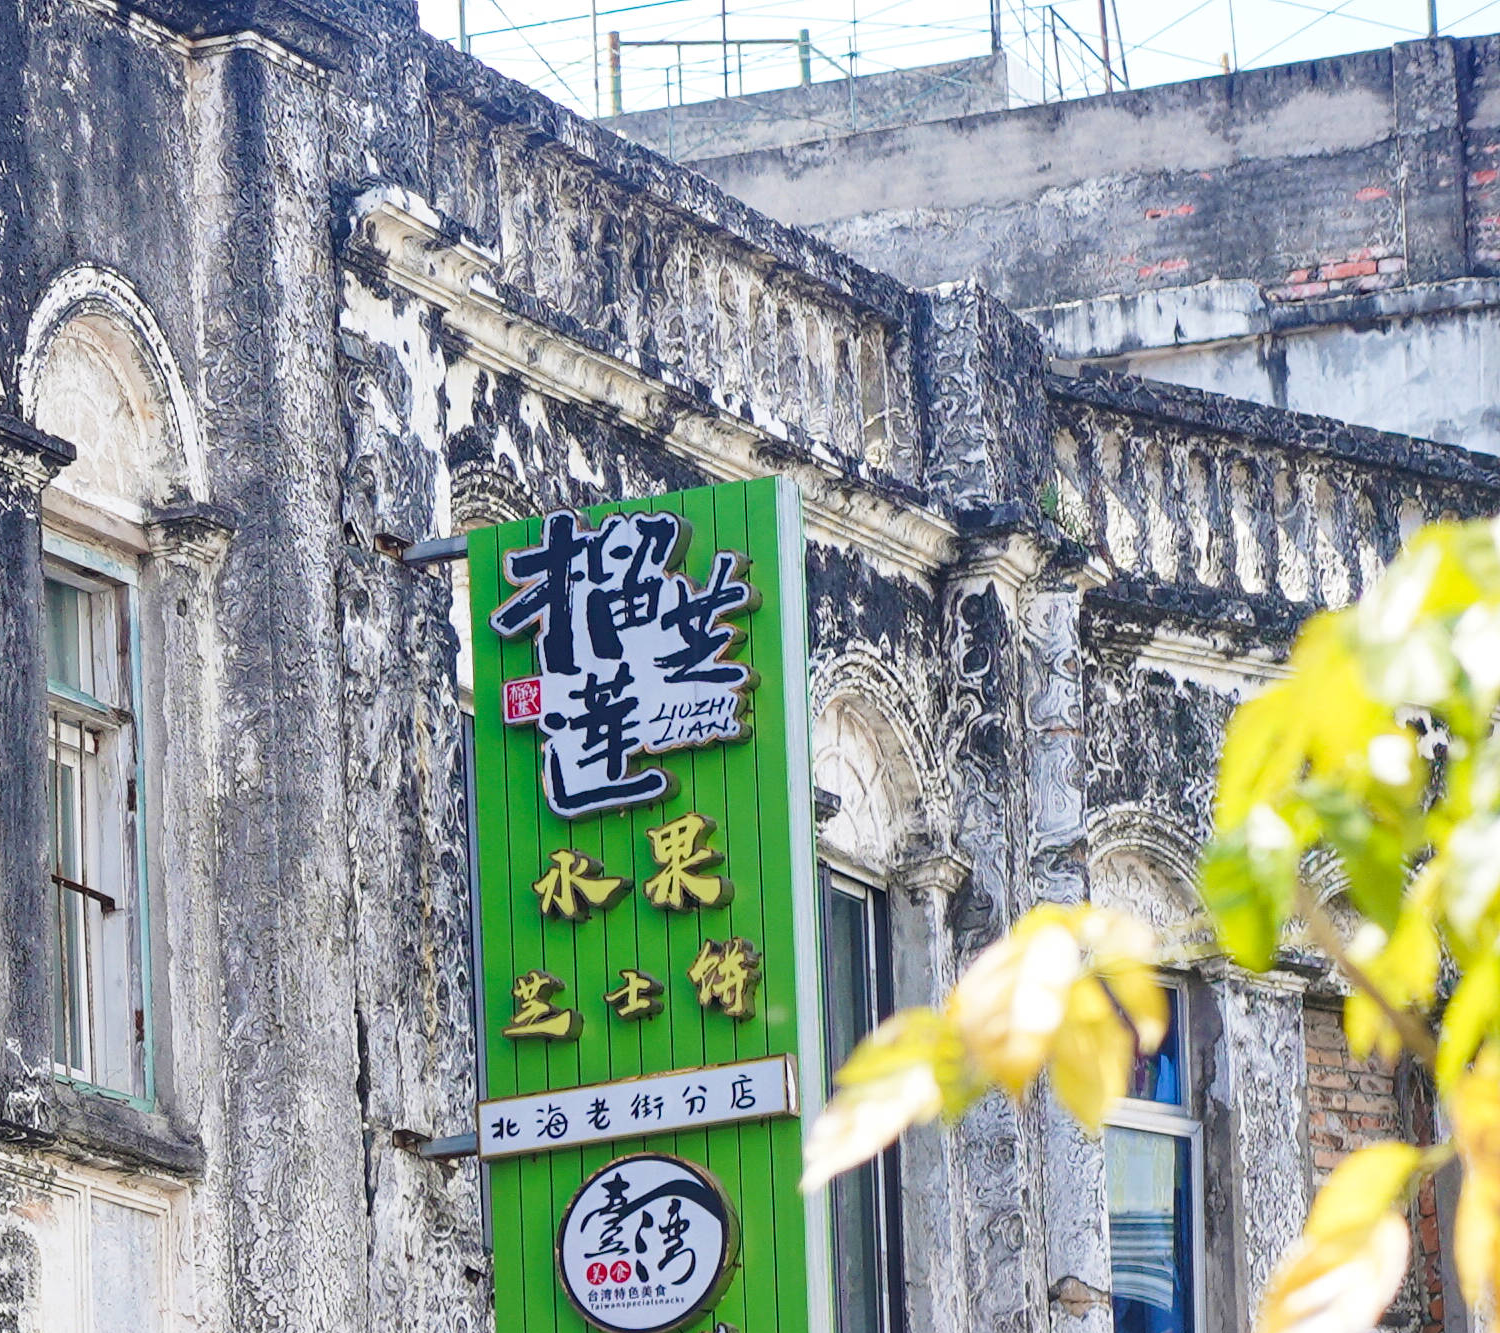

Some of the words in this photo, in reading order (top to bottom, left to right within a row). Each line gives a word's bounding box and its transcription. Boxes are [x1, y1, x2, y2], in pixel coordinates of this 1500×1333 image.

[649, 697, 735, 723] LIUZHI
[532, 812, 726, 918] 水果
[502, 938, 760, 1038] 芝士饼
[491, 1074, 756, 1139] 北海老街分店
[587, 1284, 667, 1303] 台湾特色美食
